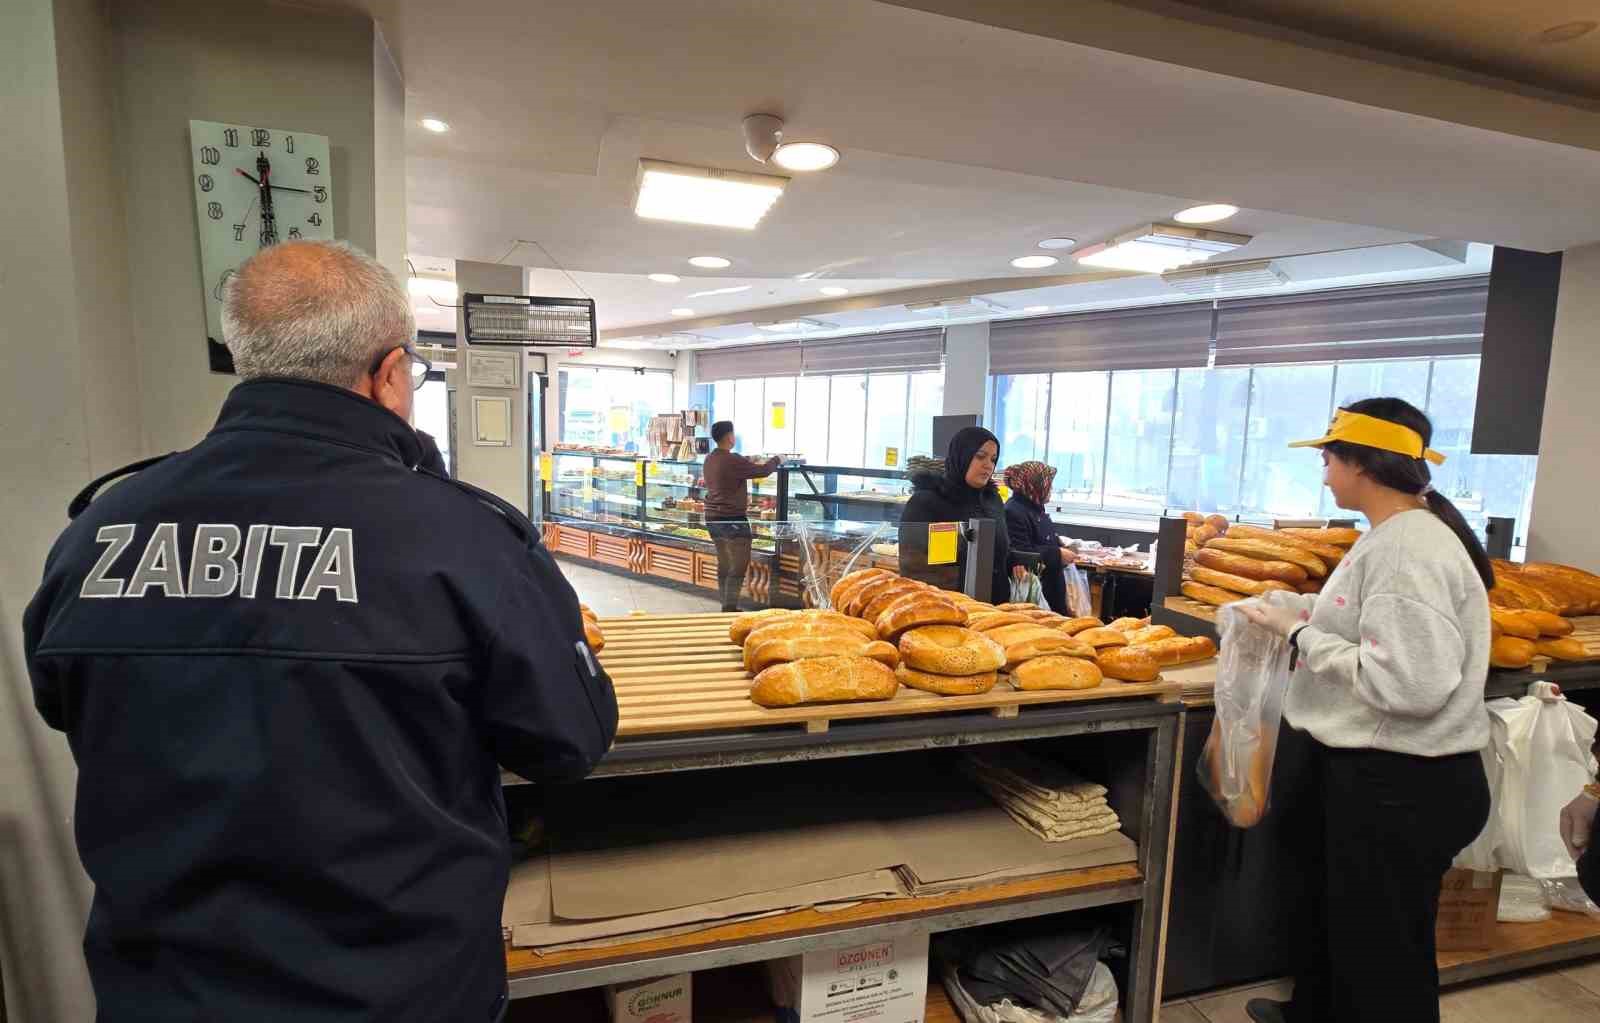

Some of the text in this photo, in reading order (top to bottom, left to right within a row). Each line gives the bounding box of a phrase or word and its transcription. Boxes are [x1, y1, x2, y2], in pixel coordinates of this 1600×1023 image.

[224, 128, 239, 148] 11
[251, 128, 271, 148] 12
[285, 135, 294, 154] 1
[200, 145, 220, 165] 10
[305, 157, 319, 175] 2
[199, 174, 214, 192] 9
[312, 185, 328, 204] 3
[207, 201, 223, 220] 8
[307, 212, 322, 227] 4
[232, 223, 246, 241] 7
[79, 523, 358, 603] ZABITA
